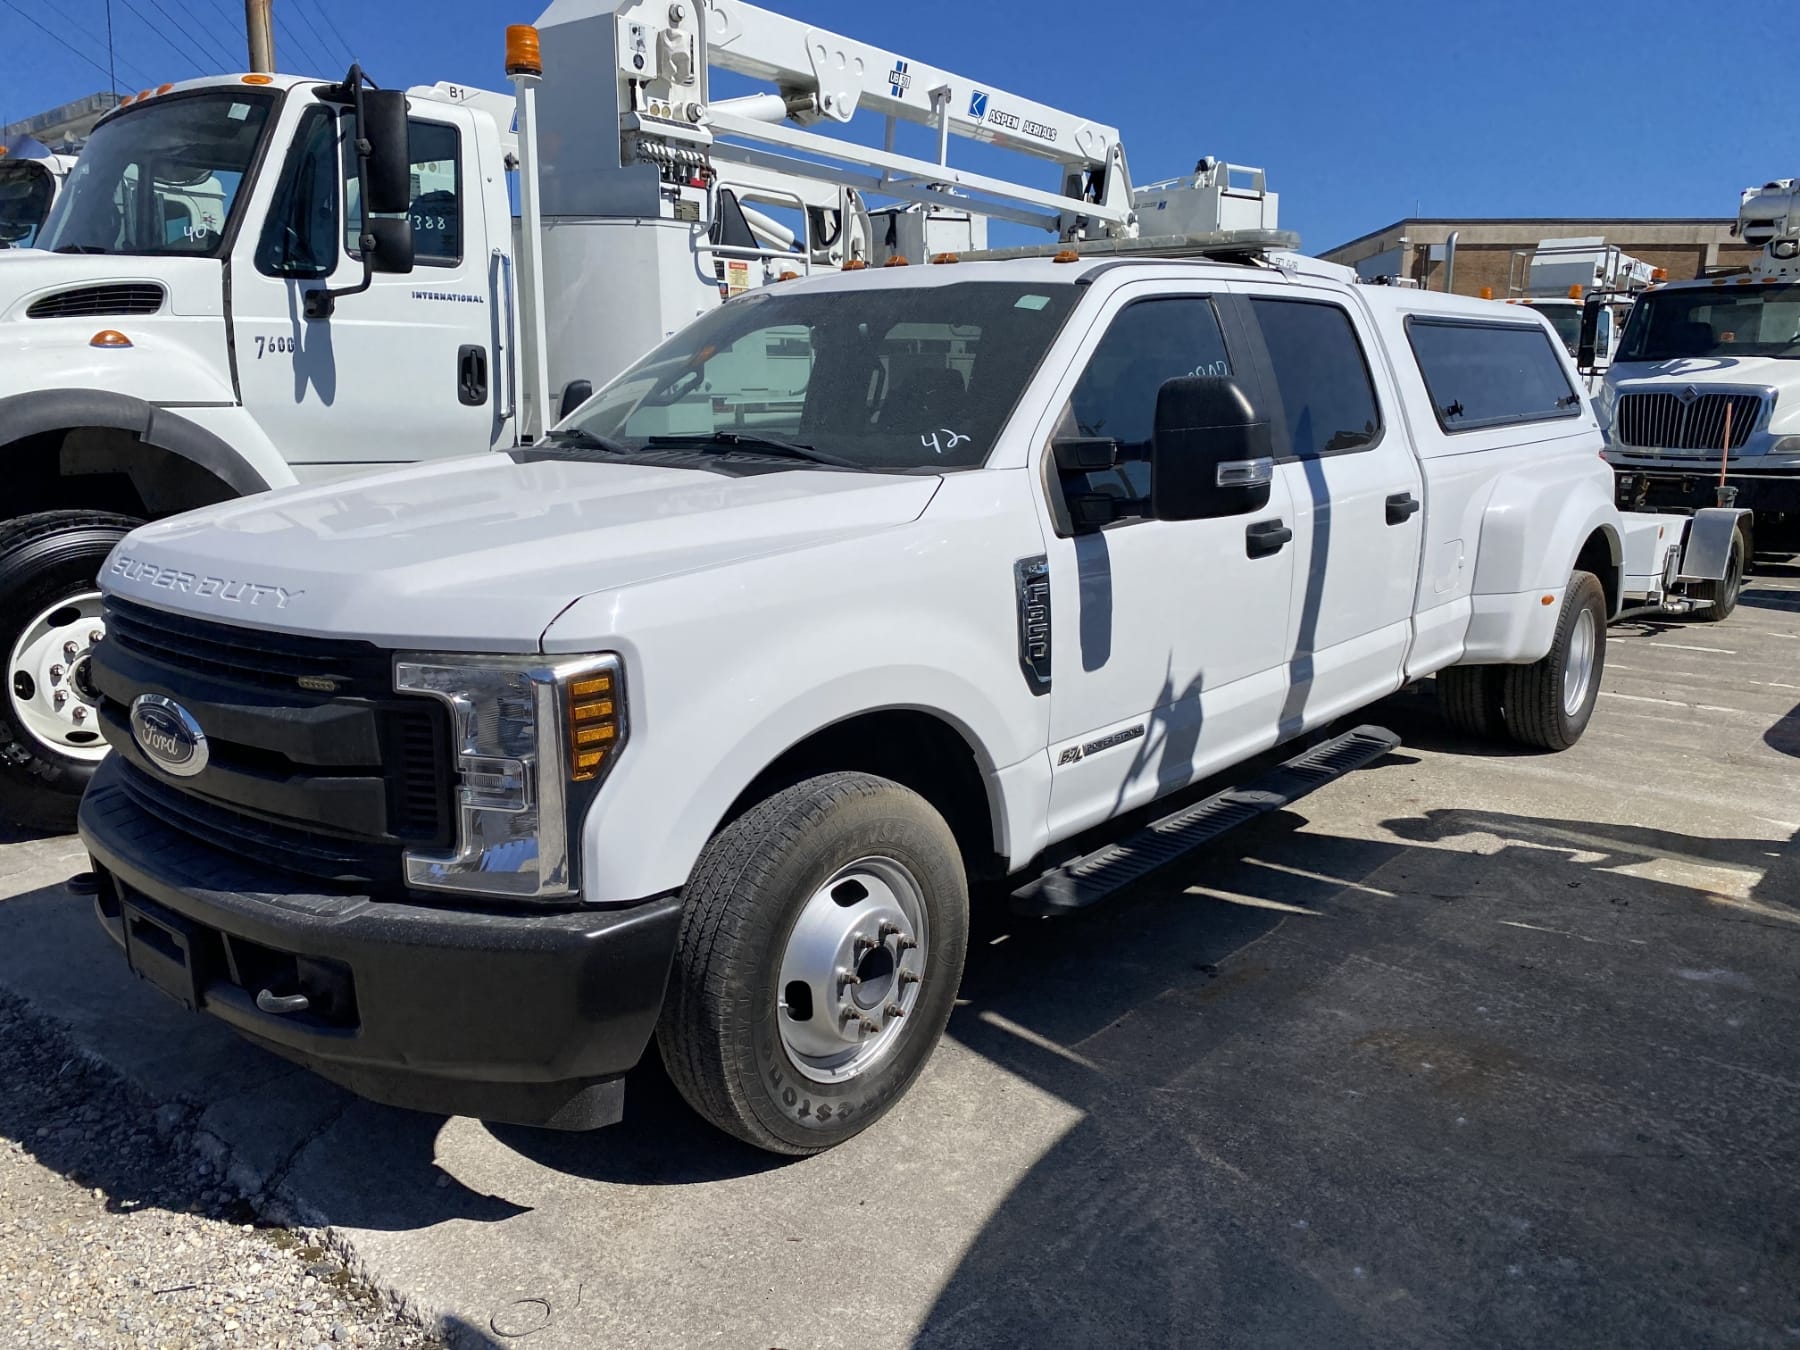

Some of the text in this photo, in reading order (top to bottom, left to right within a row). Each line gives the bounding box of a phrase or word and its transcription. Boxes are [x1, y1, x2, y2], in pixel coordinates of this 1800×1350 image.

[449, 86, 465, 101] B1
[988, 109, 1057, 142] ASPEN AERIALS
[183, 223, 207, 243] 40
[411, 290, 485, 304] INTERNATIONAL
[254, 335, 295, 360] 7600
[920, 428, 972, 454] 42
[111, 556, 196, 593] SUPER
[194, 575, 306, 609] DUTY
[142, 714, 179, 756] Ford
[1086, 737, 1113, 752] POWER
[1114, 725, 1144, 741] STROKE
